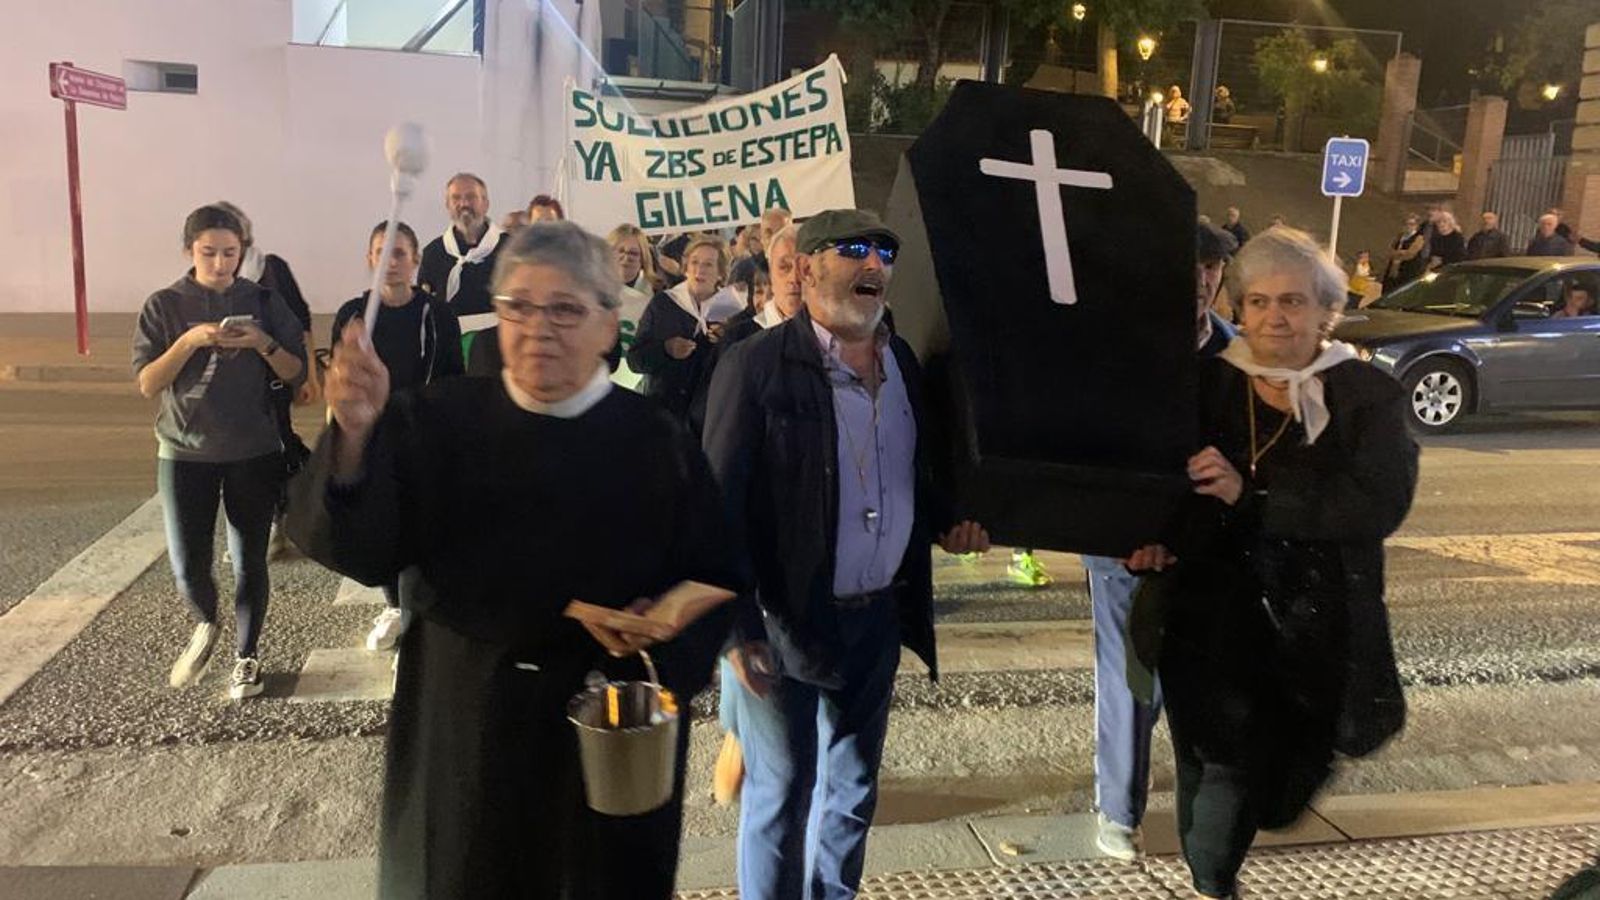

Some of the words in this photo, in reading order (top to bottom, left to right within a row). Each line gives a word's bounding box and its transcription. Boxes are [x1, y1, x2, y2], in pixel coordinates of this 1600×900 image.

[573, 71, 828, 138] SOLUCIONES
[574, 140, 622, 182] YA
[645, 150, 707, 179] ZBS
[713, 149, 737, 167] DE
[742, 122, 843, 169] ESTEPA
[1330, 154, 1362, 167] TAXI
[635, 178, 791, 229] GILENA
